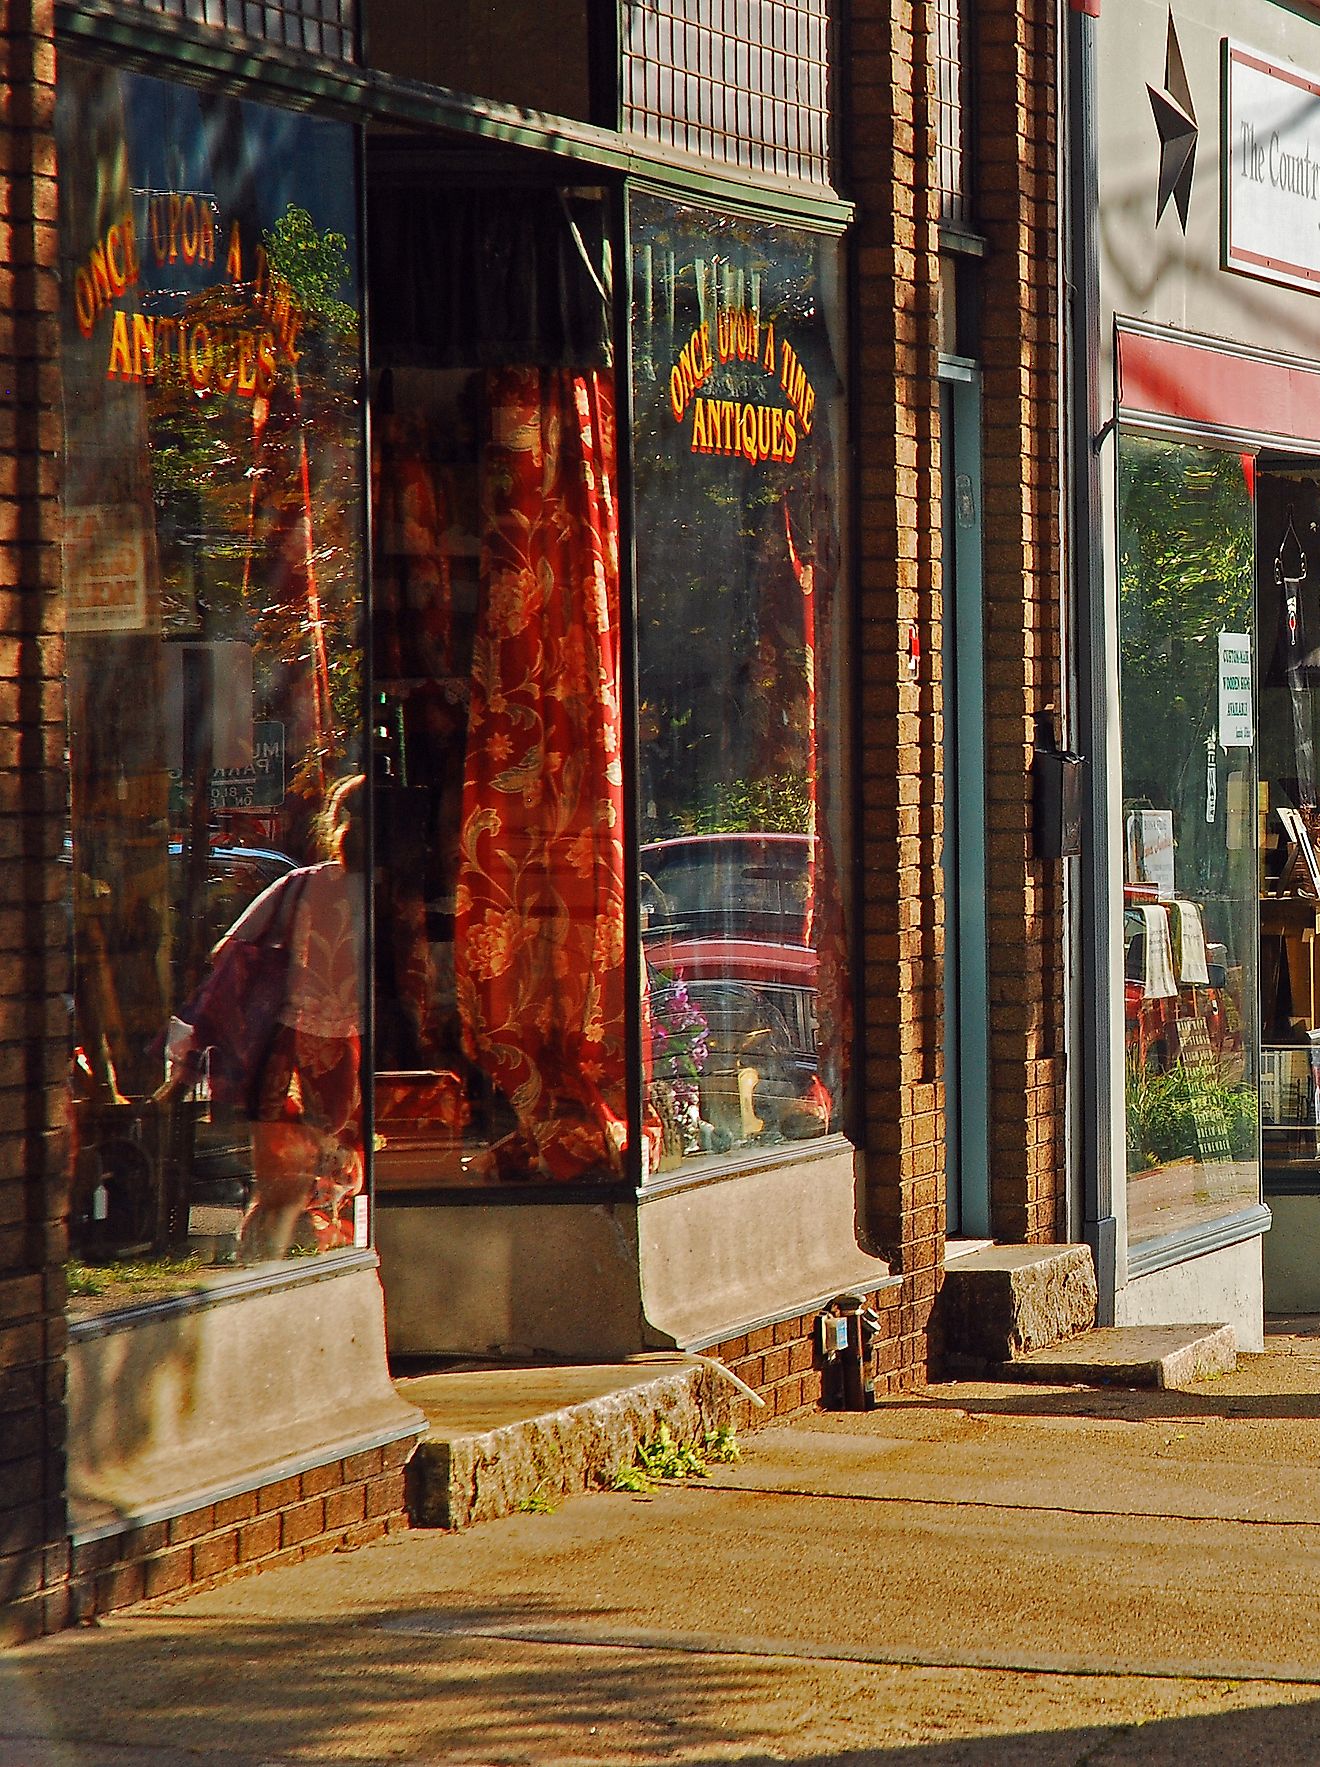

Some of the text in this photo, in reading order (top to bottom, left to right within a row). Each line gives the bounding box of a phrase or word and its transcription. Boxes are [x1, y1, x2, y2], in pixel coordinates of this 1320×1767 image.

[1240, 120, 1265, 184] The
[75, 212, 140, 339] ONCE
[151, 195, 215, 268] UPON
[226, 218, 243, 282] A
[107, 310, 276, 398] ANTIQUES
[670, 308, 817, 436] ONCE UPON A TIME
[690, 397, 798, 467] ANTIQUES
